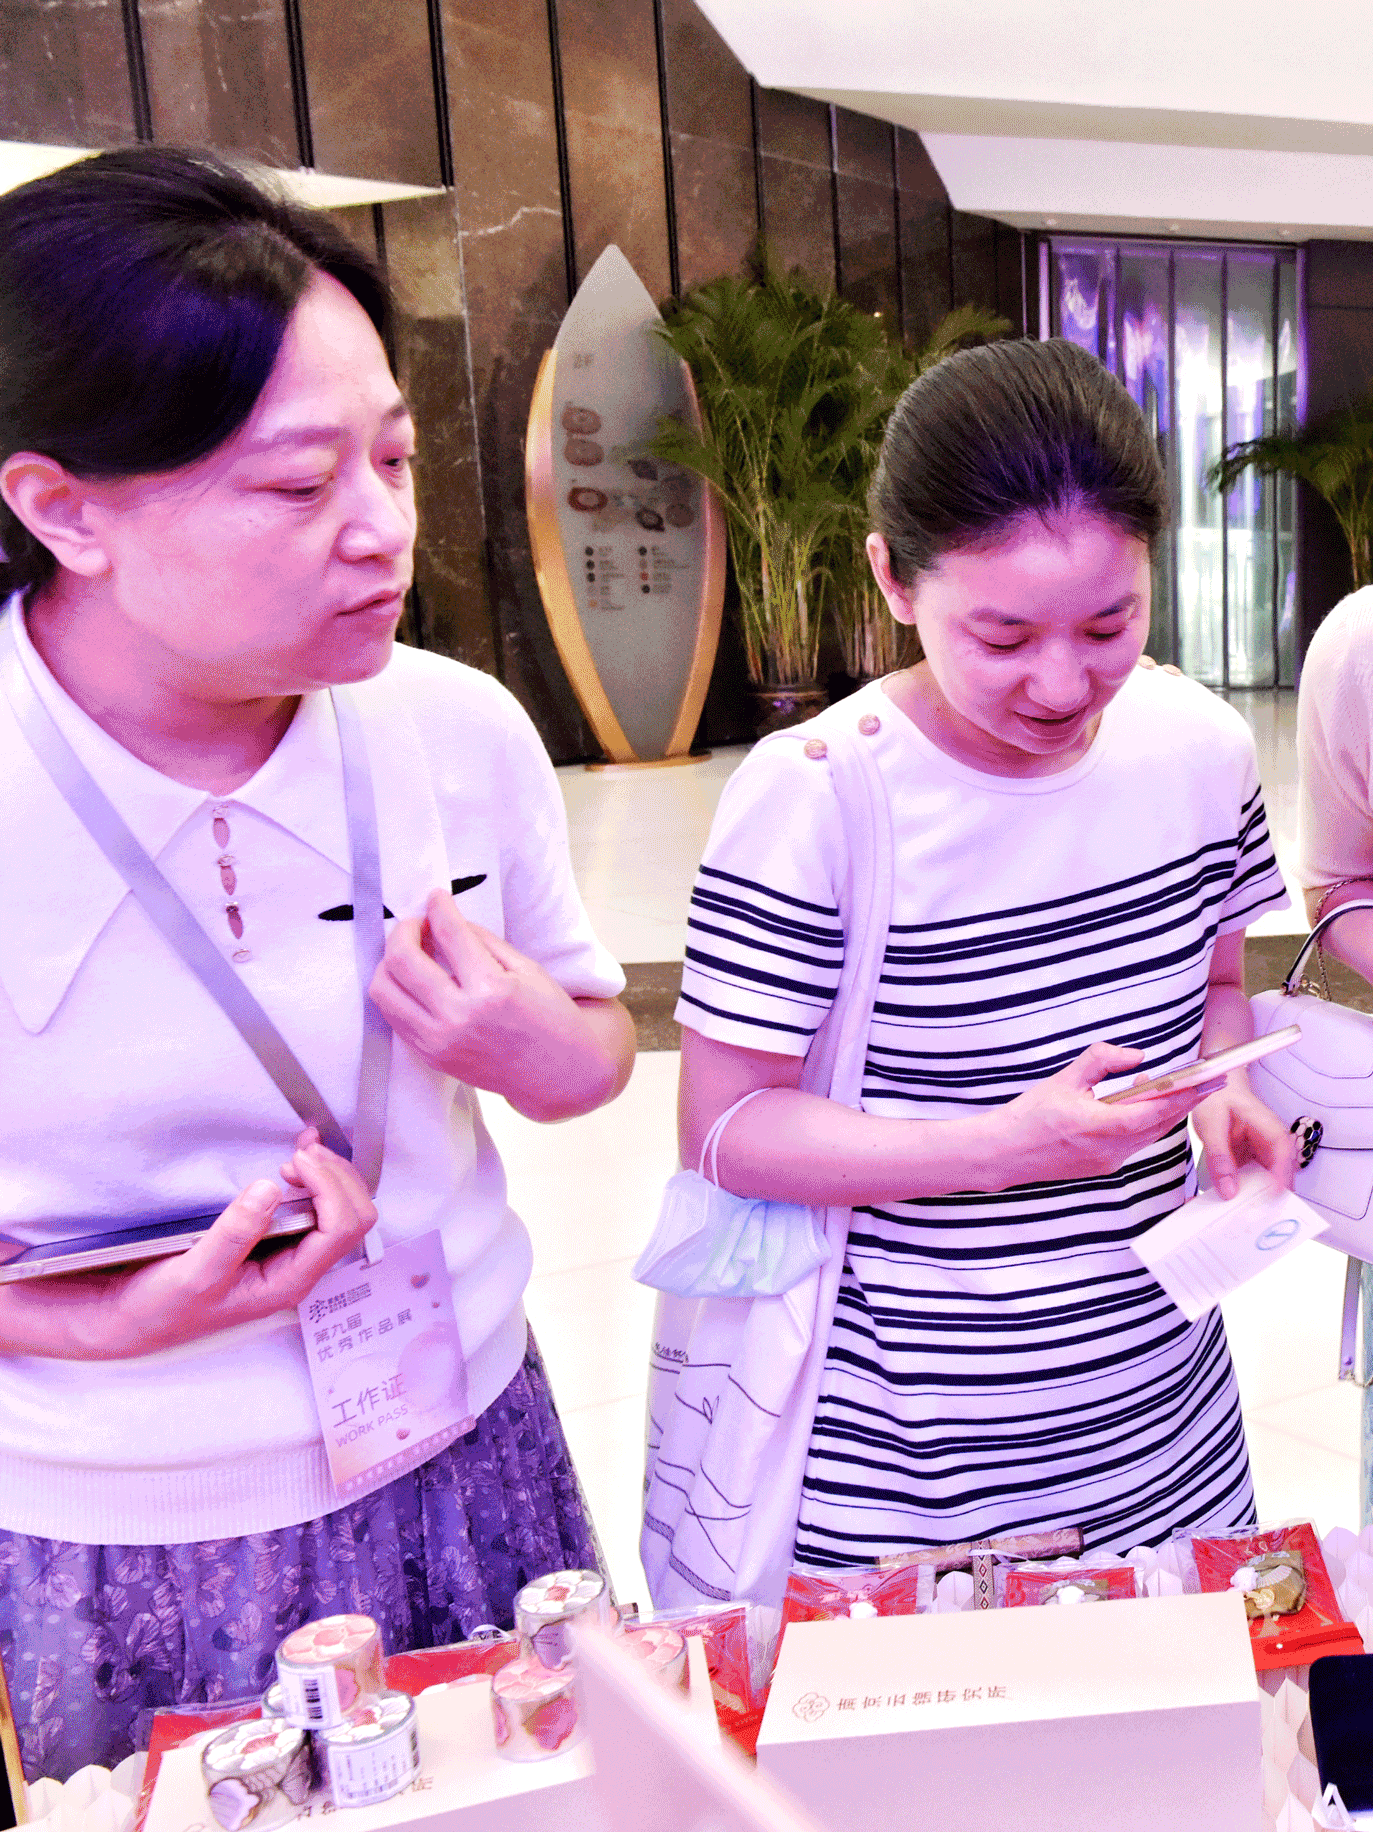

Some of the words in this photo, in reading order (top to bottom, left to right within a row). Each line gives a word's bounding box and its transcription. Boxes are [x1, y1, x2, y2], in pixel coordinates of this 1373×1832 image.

[312, 1313, 362, 1346] 第九届
[316, 1308, 413, 1362] 优秀作品展
[331, 1373, 407, 1428] 工作证
[335, 1420, 375, 1448] WORK
[377, 1403, 409, 1427] PASS
